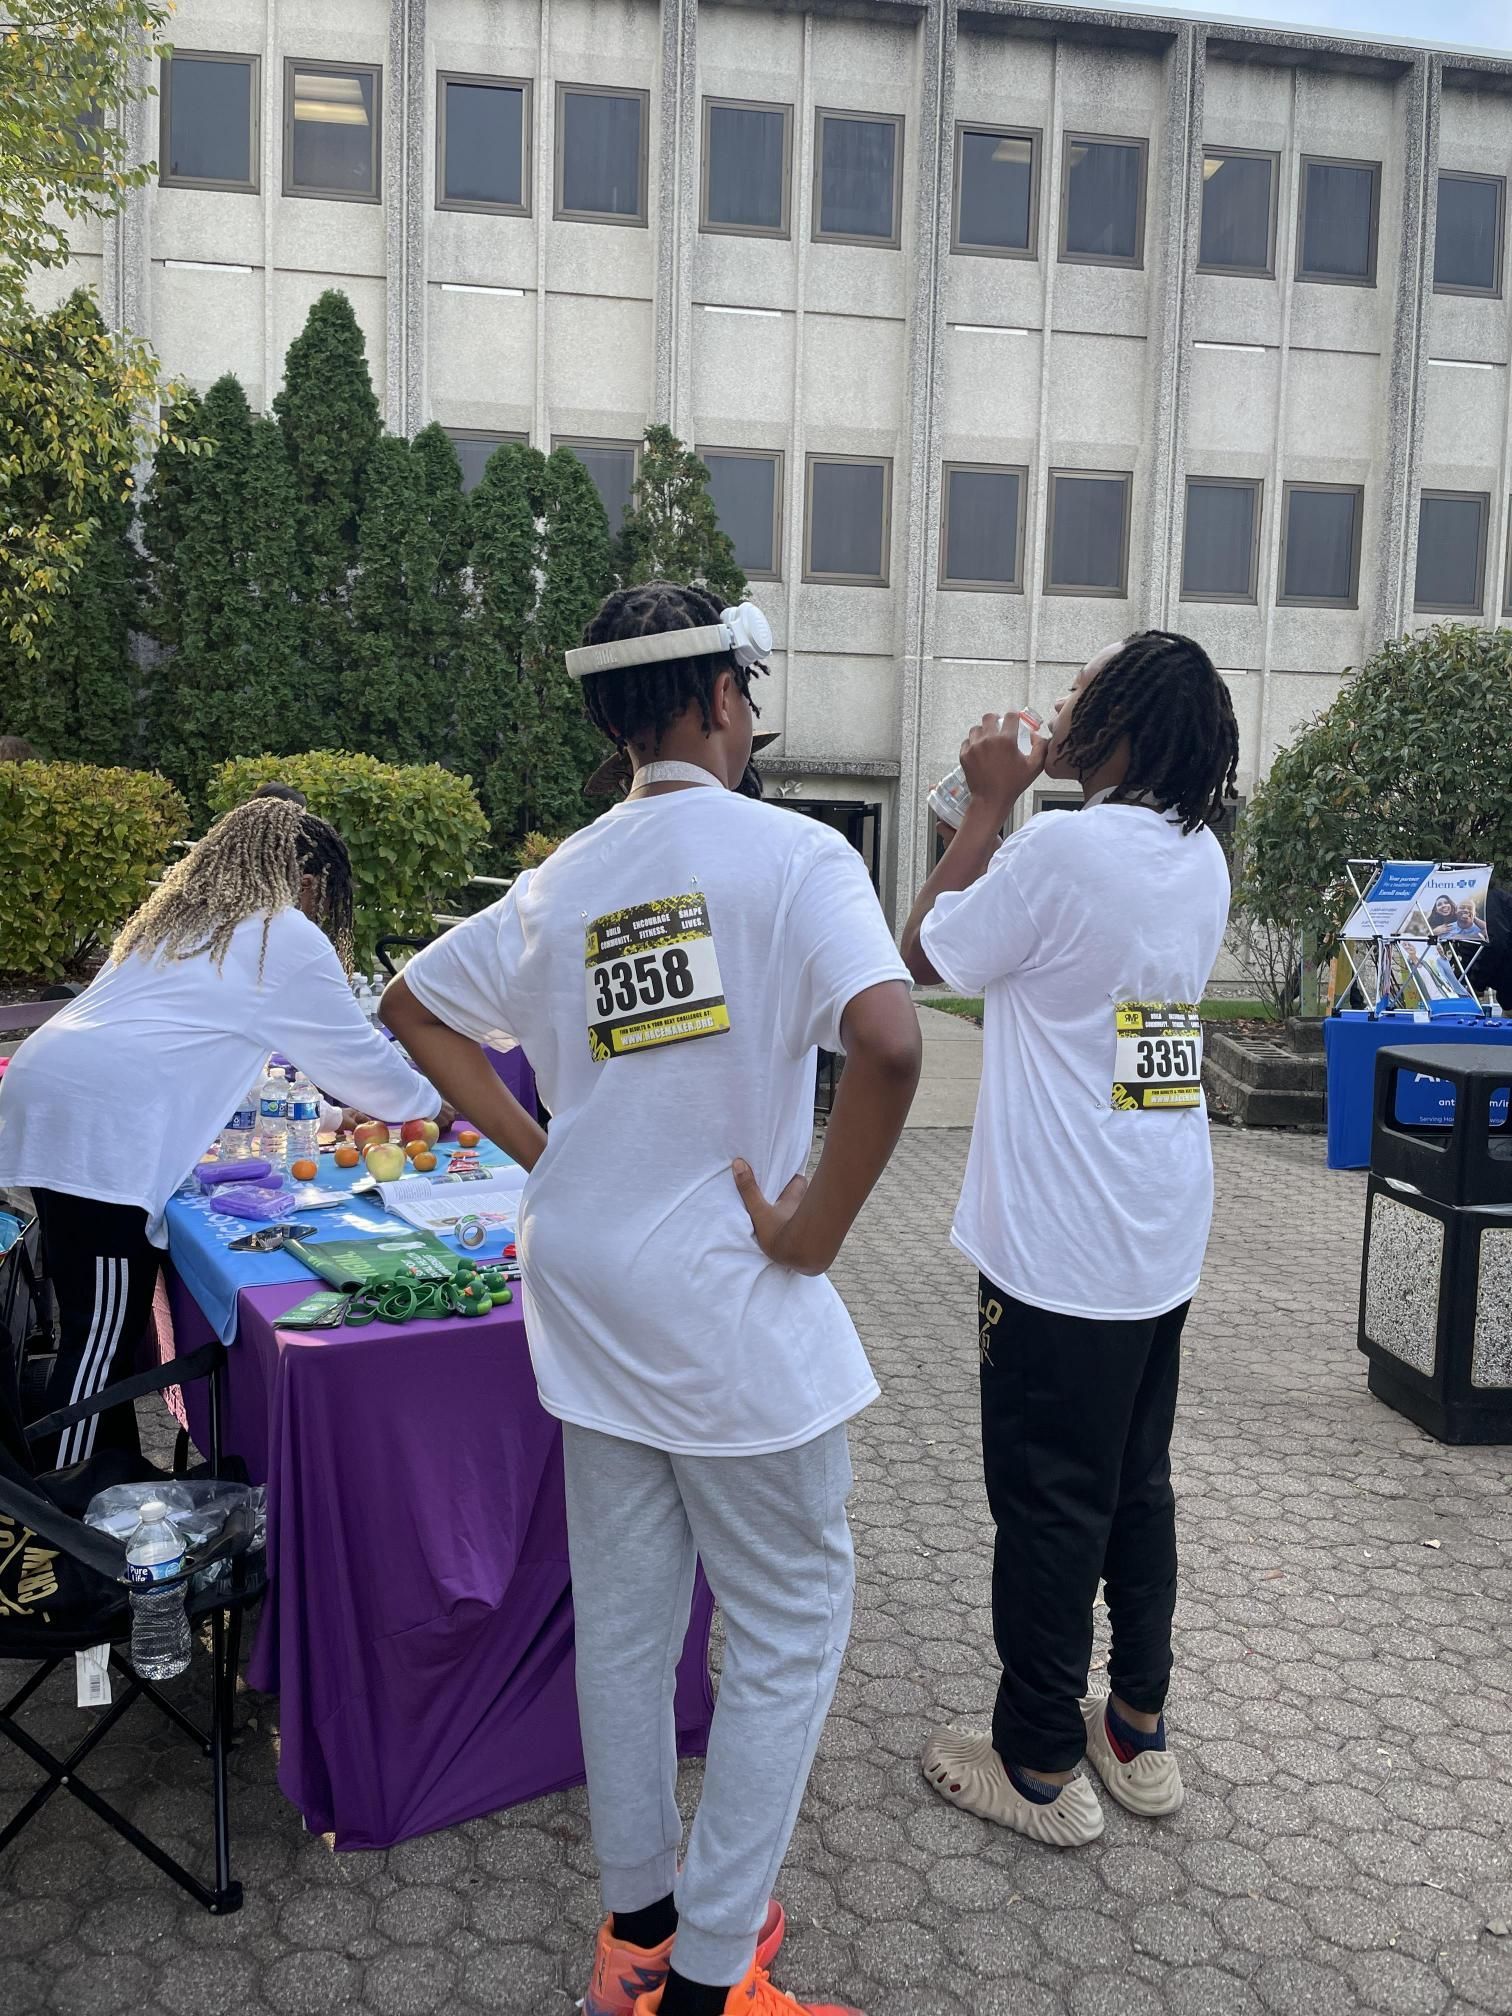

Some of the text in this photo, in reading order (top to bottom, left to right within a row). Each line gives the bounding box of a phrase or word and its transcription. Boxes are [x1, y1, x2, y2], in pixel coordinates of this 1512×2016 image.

[679, 907, 703, 919] SHAPE
[632, 913, 671, 930] ENCOURAGE
[681, 918, 704, 930] LIVES.
[606, 926, 622, 938] BUILD
[639, 925, 668, 940] FITNESS.
[594, 948, 694, 1017] 3358
[1419, 1116, 1443, 1124] Serving
[129, 1565, 148, 1576] Pure
